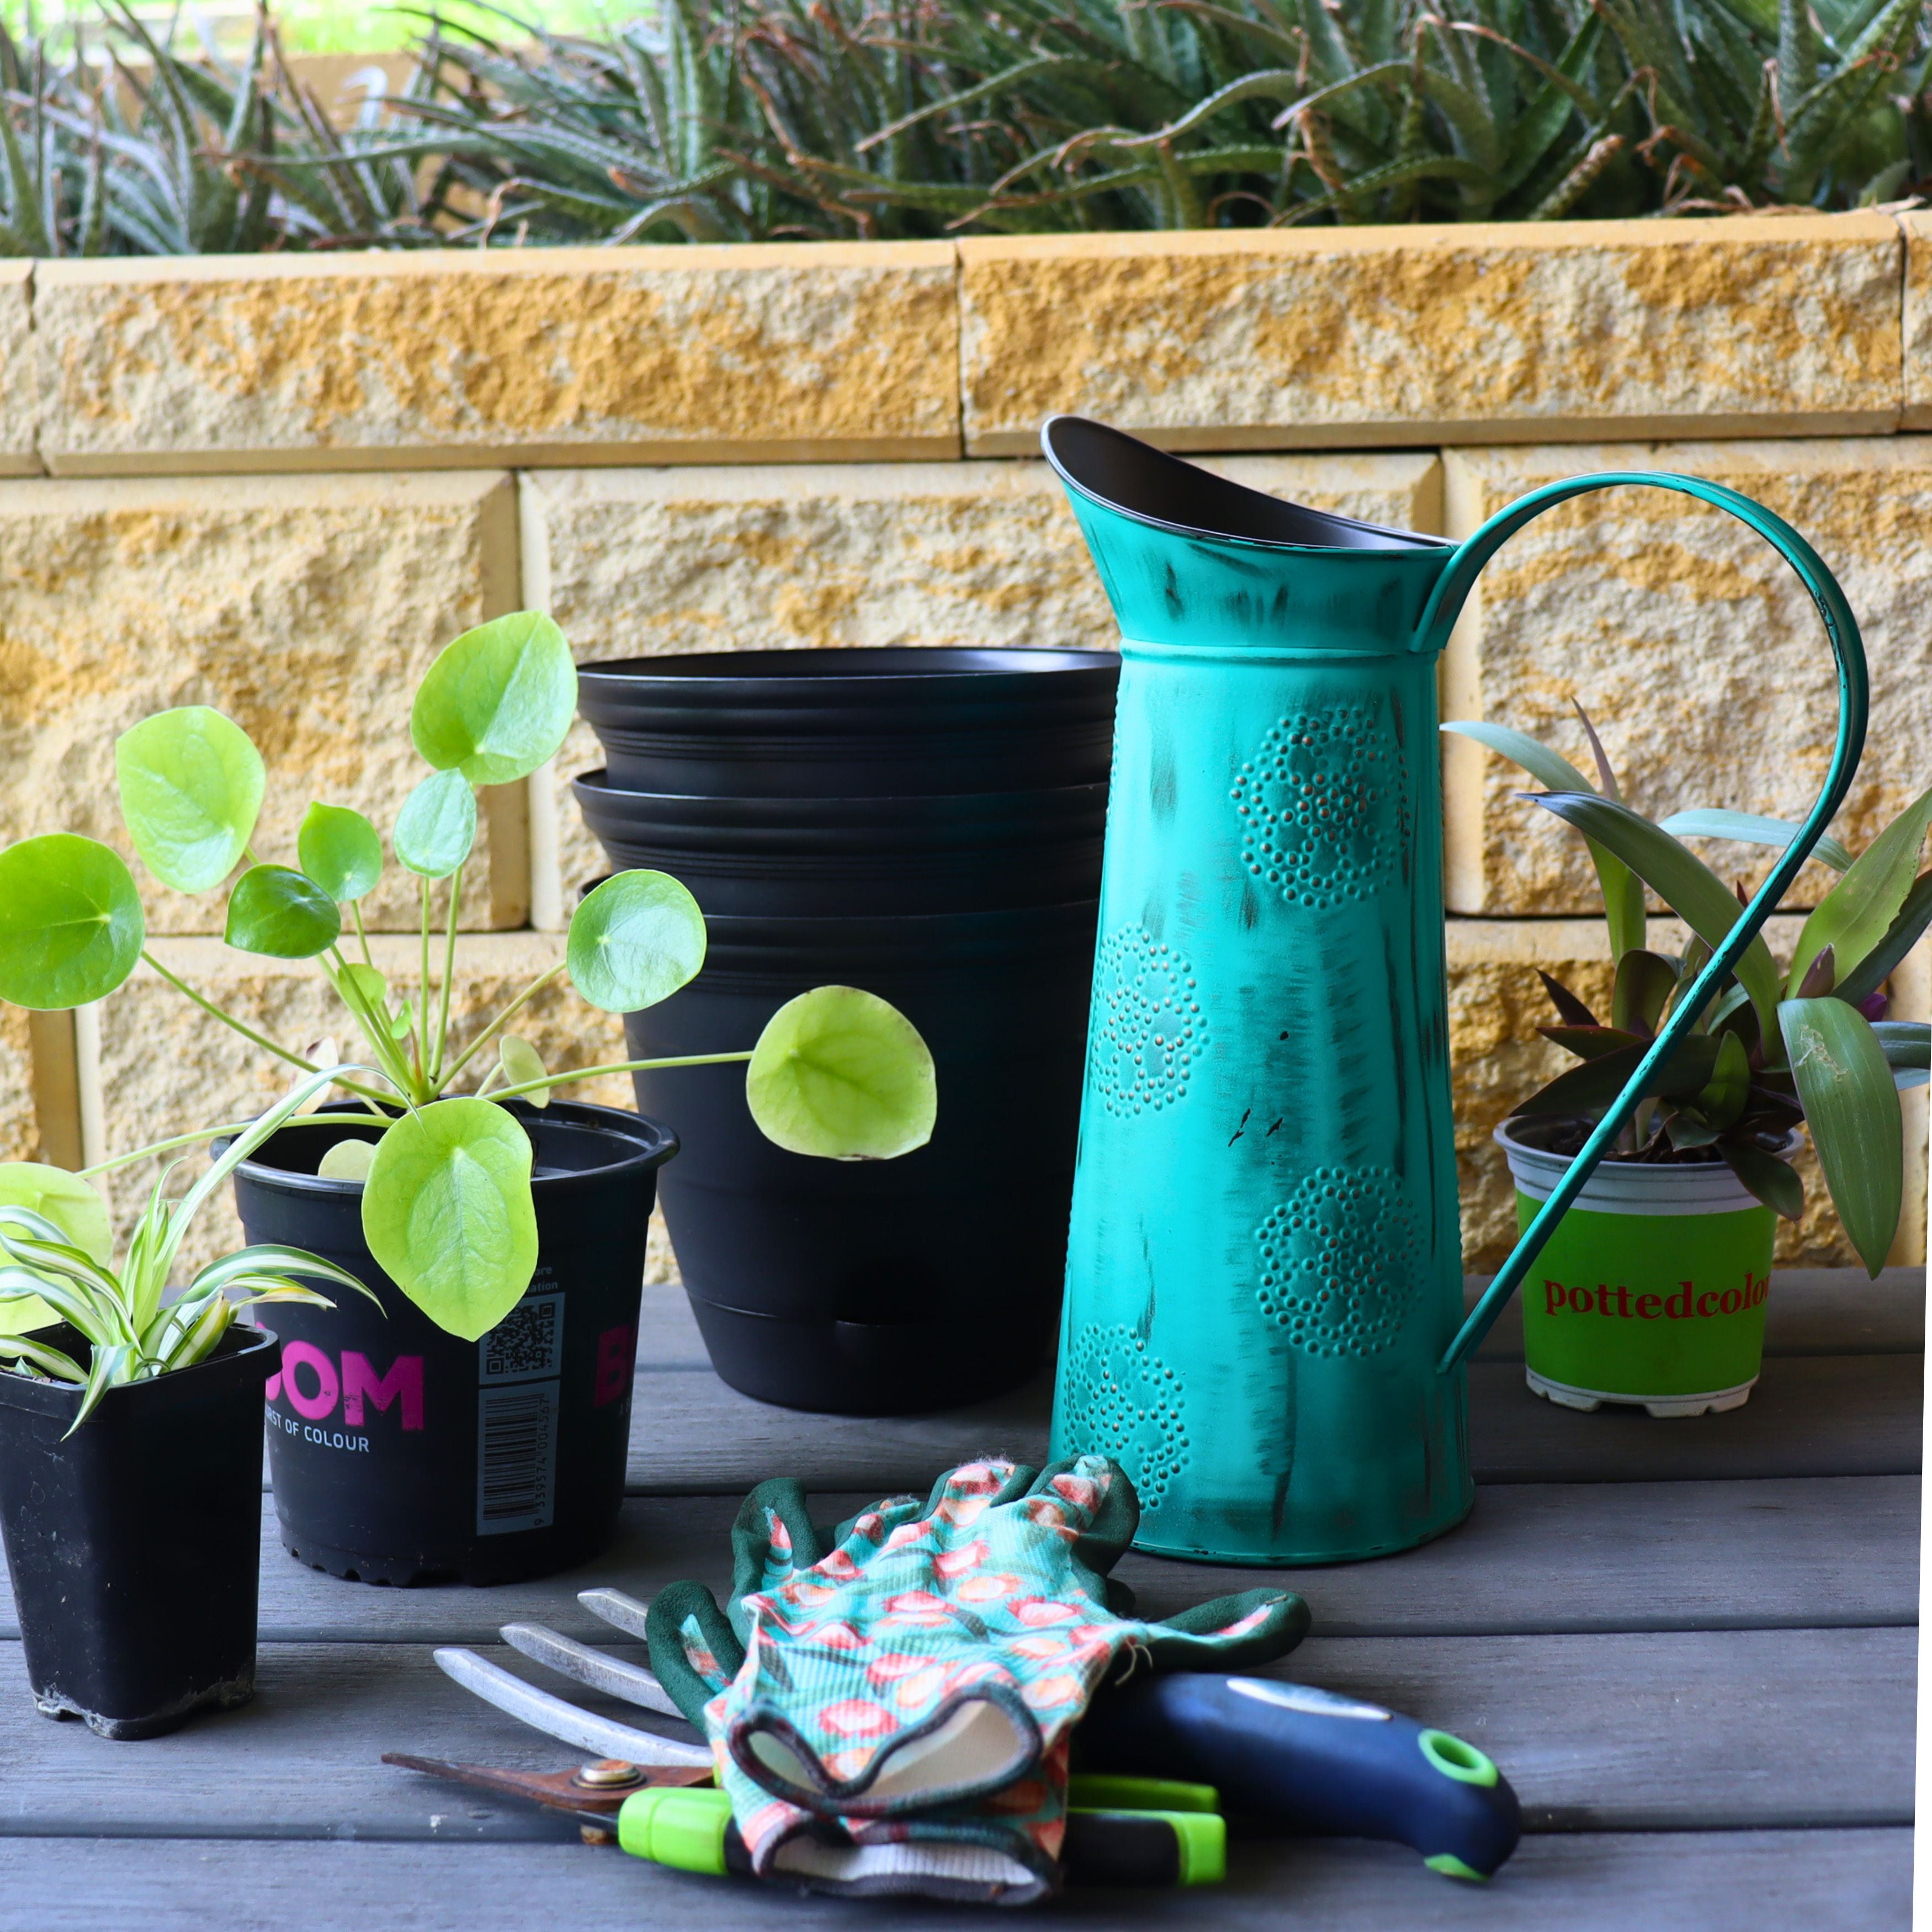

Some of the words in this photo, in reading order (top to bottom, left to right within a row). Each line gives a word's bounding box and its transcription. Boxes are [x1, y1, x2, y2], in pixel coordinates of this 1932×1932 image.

[534, 1265, 553, 1276] ore
[527, 1281, 559, 1292] ation
[594, 1325, 631, 1409] B
[285, 1418, 299, 1436] OF
[304, 1425, 370, 1453] COLOUR
